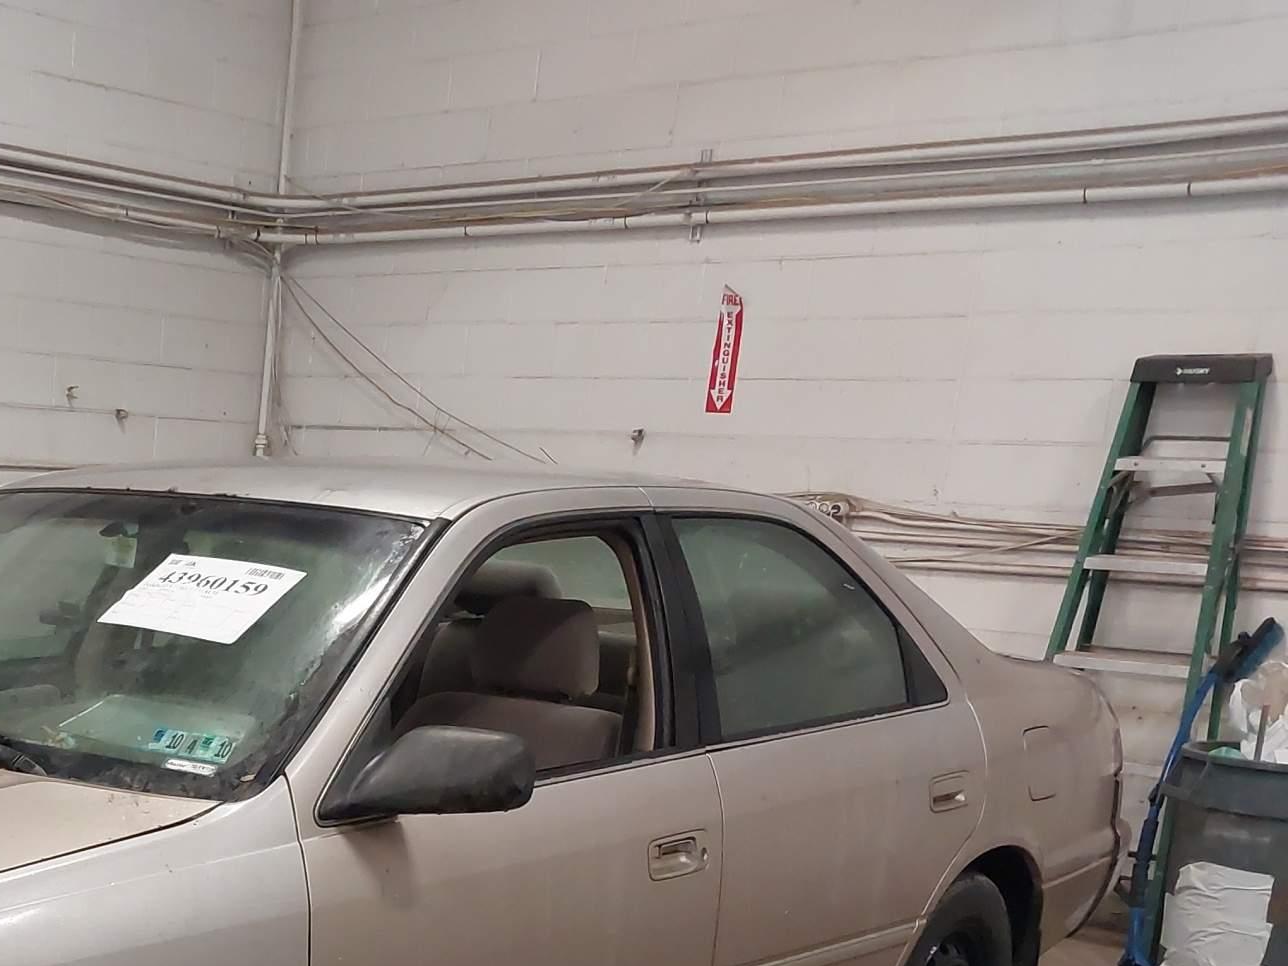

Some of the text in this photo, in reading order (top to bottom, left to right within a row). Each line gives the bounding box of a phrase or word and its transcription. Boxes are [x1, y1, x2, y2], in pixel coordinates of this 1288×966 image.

[722, 293, 740, 306] FIRE
[716, 311, 734, 402] EXTINGUISHER
[158, 570, 268, 598] 43960159
[165, 732, 185, 750] 10
[214, 740, 233, 759] 10
